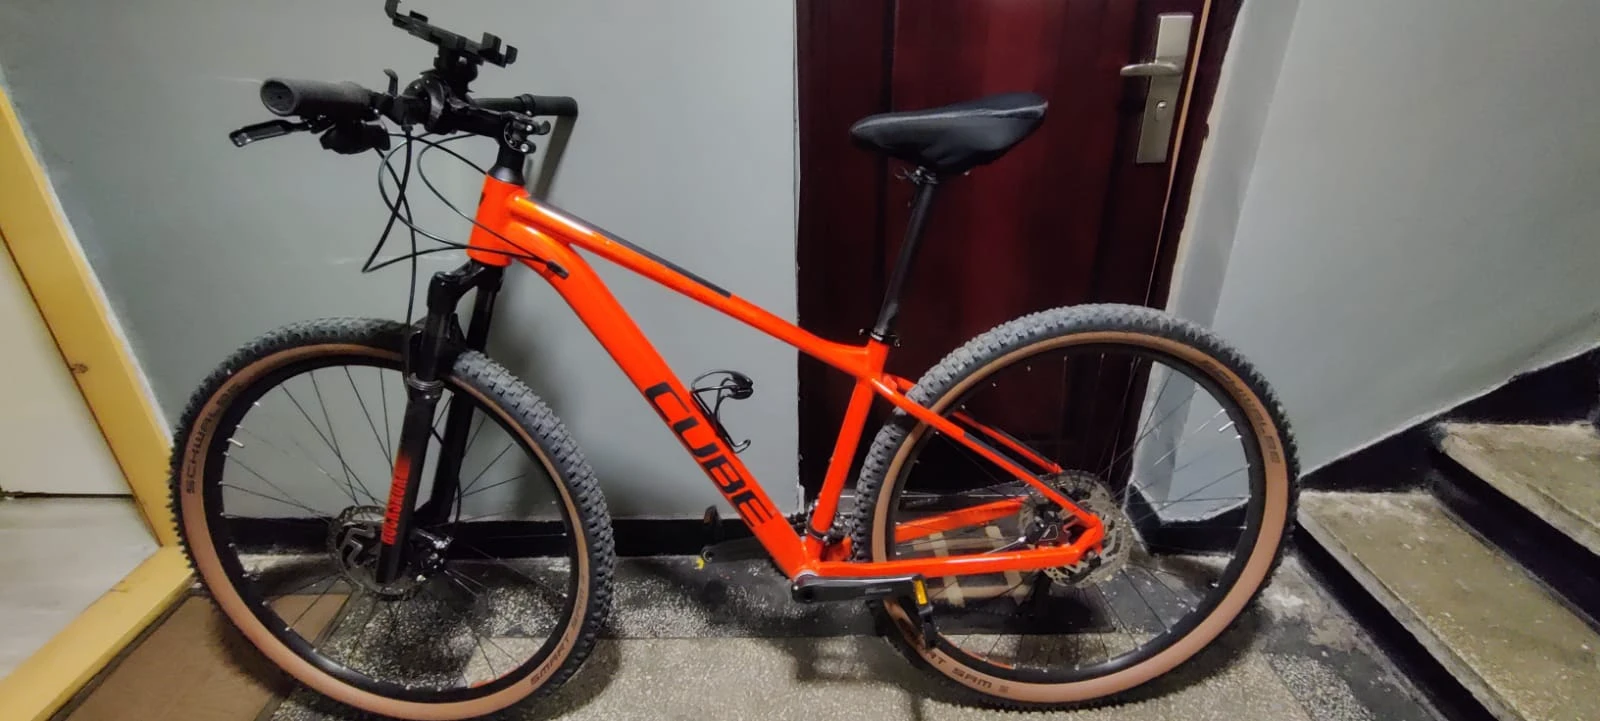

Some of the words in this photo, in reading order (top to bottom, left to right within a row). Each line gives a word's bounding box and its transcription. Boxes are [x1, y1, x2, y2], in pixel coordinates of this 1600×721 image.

[645, 381, 773, 527] CUBE
[529, 634, 569, 685] SMART
[951, 666, 992, 689] SAM
